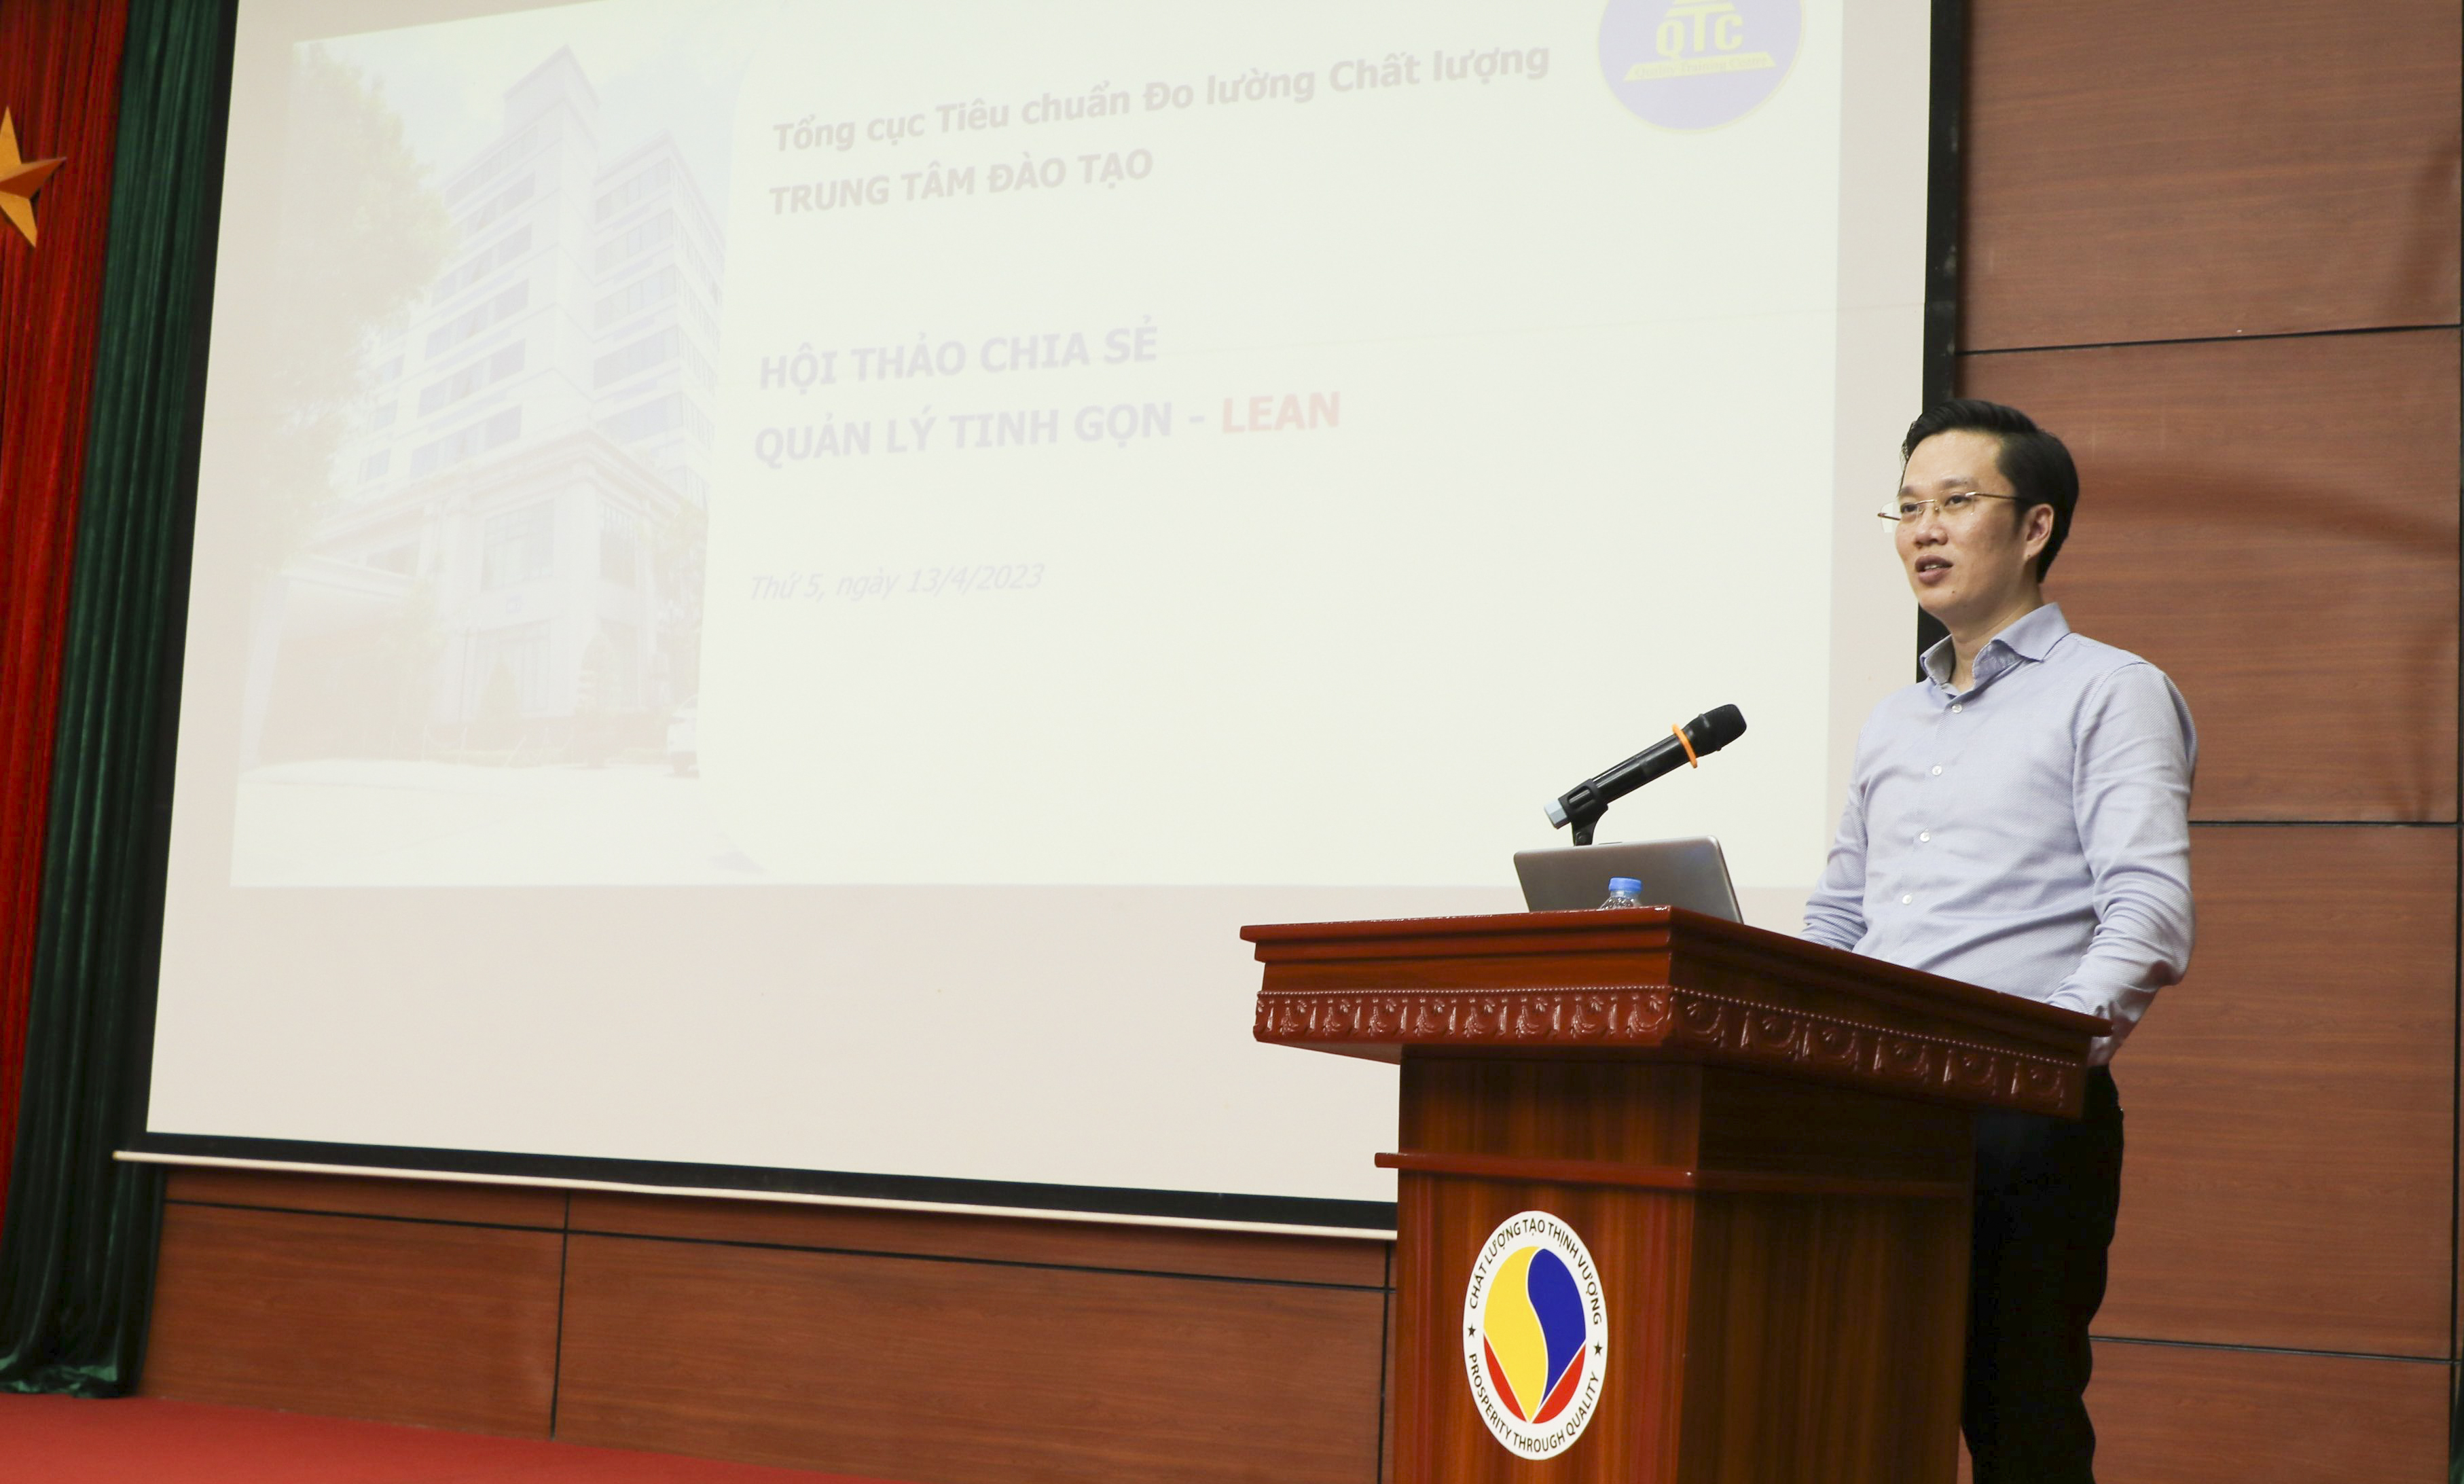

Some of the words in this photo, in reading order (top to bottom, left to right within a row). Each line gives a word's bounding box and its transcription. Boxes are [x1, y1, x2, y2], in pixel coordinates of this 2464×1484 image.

[1656, 3, 1743, 60] QTC
[773, 113, 856, 152] Tổng
[867, 113, 926, 146] cục
[935, 97, 1010, 133] Tiêu
[1021, 79, 1131, 125] chuẩn
[1142, 81, 1194, 111] Đo
[1207, 67, 1316, 105] lường
[1329, 52, 1421, 92] Chất
[1433, 46, 1550, 85] lượng
[769, 175, 890, 215] TRUNG
[900, 160, 975, 202] TÂM
[987, 151, 1067, 194] ĐÀO
[1077, 148, 1153, 189] TẠO
[759, 342, 838, 395] HỘI
[850, 331, 966, 382] THẢO
[980, 332, 1090, 374] CHIA
[1103, 314, 1158, 365] SẺ
[755, 412, 871, 469] QUẢN
[886, 404, 937, 454] LÝ
[948, 409, 1059, 450] TINH
[1074, 401, 1172, 448] GỌN
[1222, 391, 1341, 434] LEAN
[750, 571, 803, 600] Thứ
[804, 573, 826, 603] 5,
[835, 566, 901, 602] ngày
[906, 562, 1046, 598] 13/4/2023
[1522, 1217, 1546, 1236] TẠO
[1547, 1222, 1579, 1259] THỊNH
[1468, 1352, 1512, 1440] PROSPERITY
[1513, 1429, 1566, 1453] THROUGH
[1565, 1371, 1599, 1436] QUALITY
